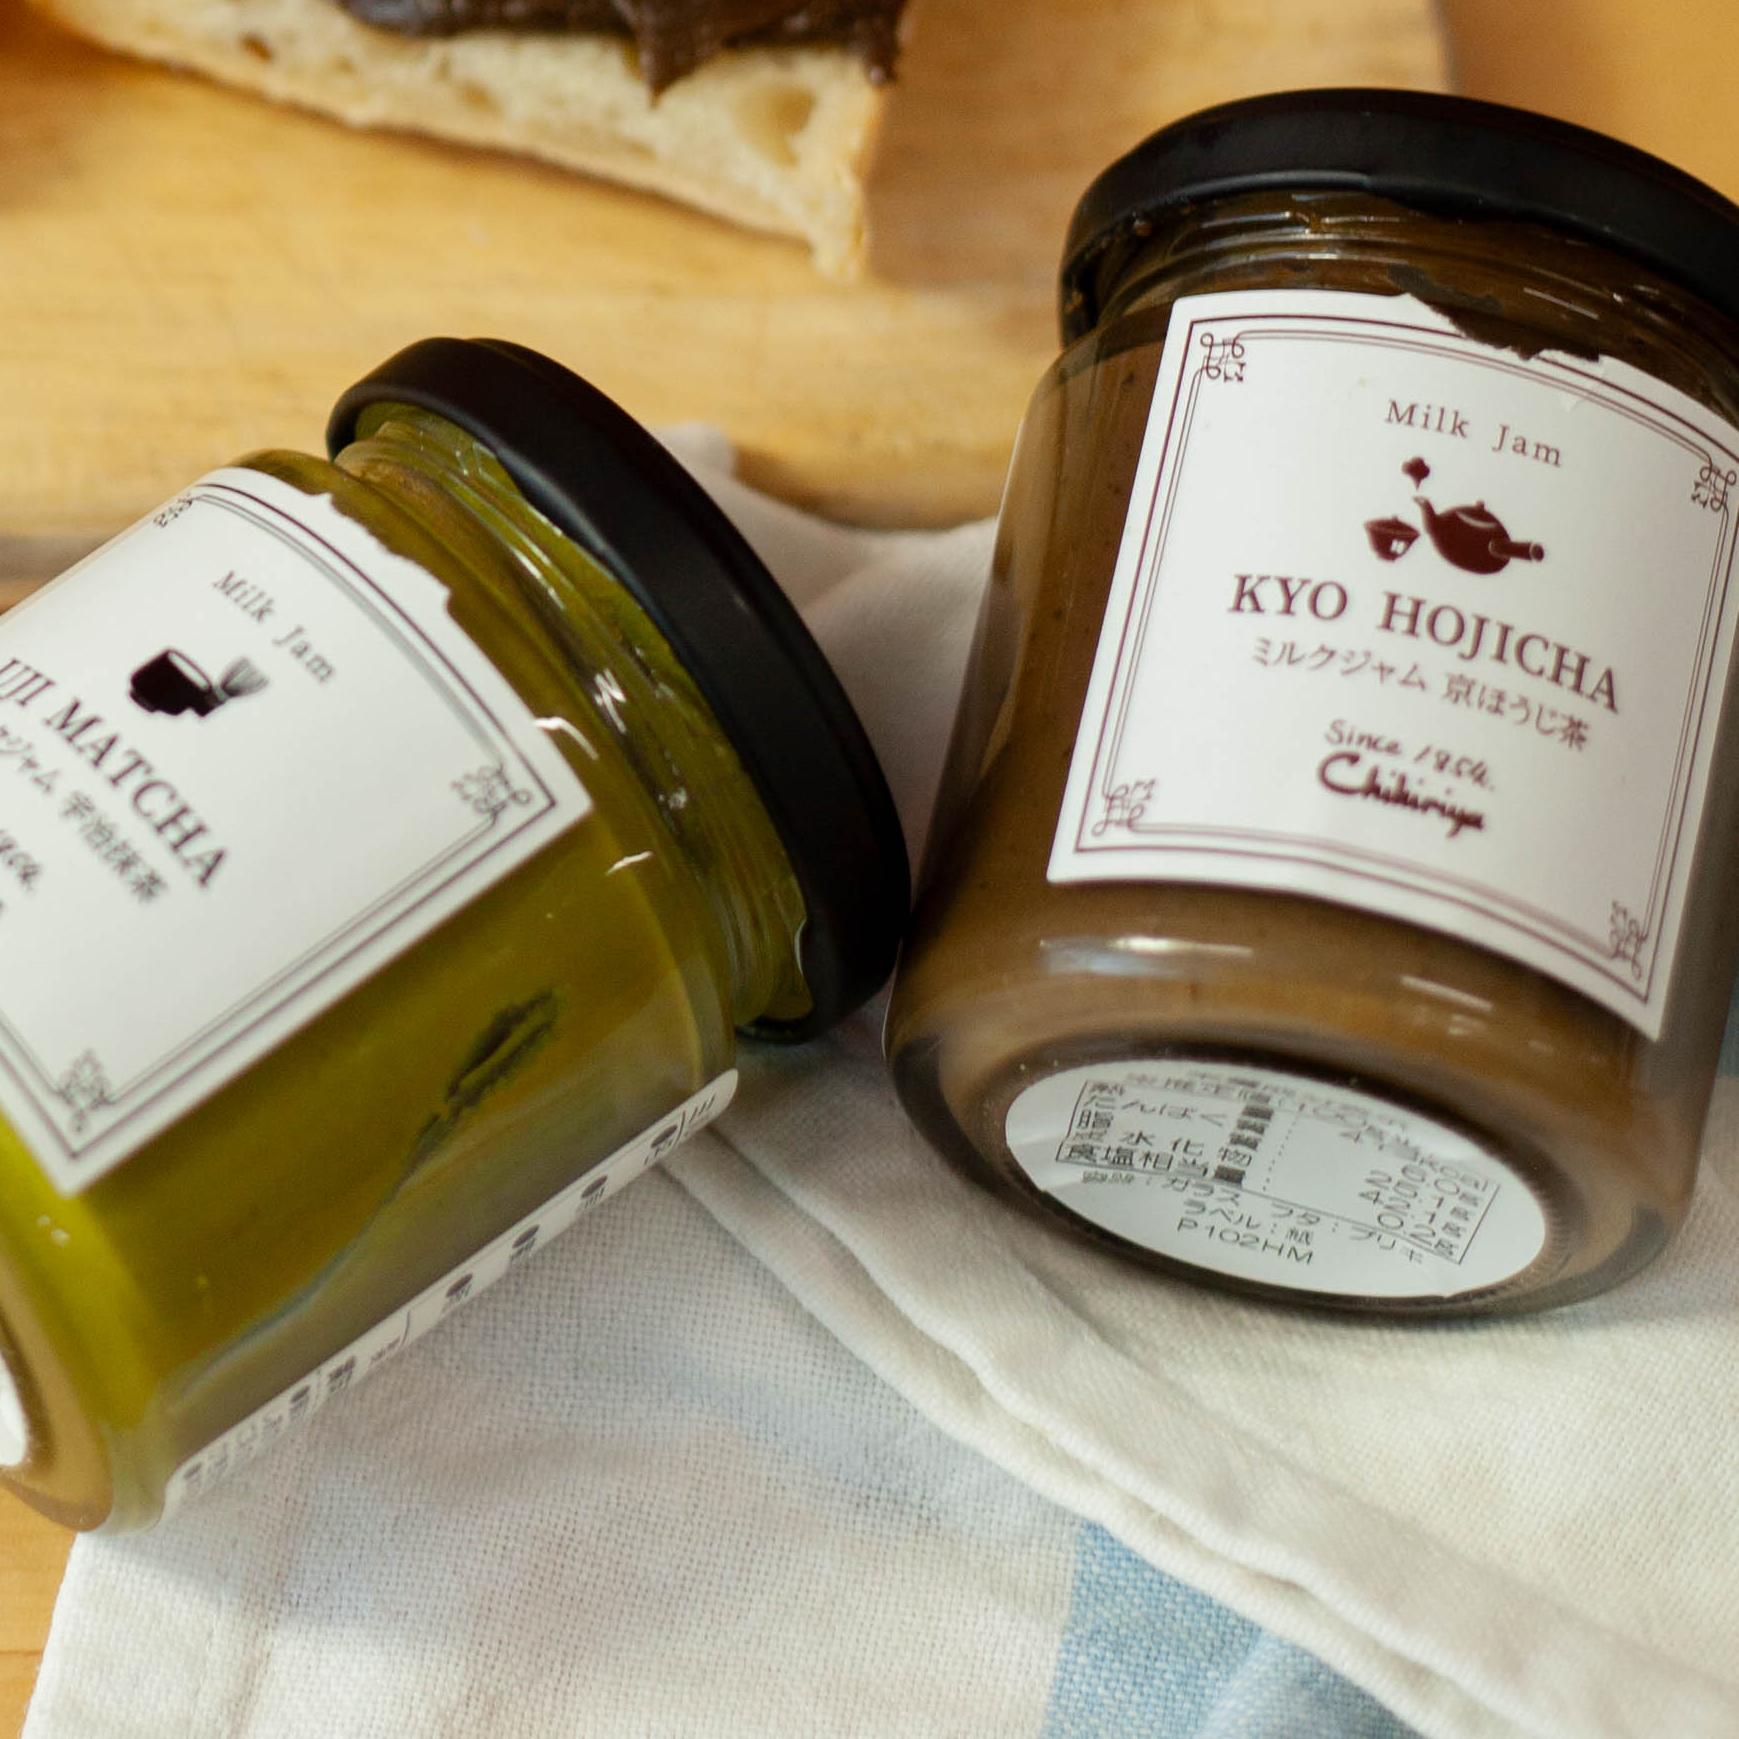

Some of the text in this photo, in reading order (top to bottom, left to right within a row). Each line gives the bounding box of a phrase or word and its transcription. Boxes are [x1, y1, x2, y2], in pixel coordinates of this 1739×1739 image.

[1385, 398, 1561, 468] Milk Jam
[212, 570, 335, 684] Milk Jam
[1227, 573, 1620, 715] KYO HOJICHA
[1251, 636, 1591, 752] ミルクジャム 京ほうじ茶
[1324, 718, 1403, 756] Since
[44, 697, 228, 888] MATCHA
